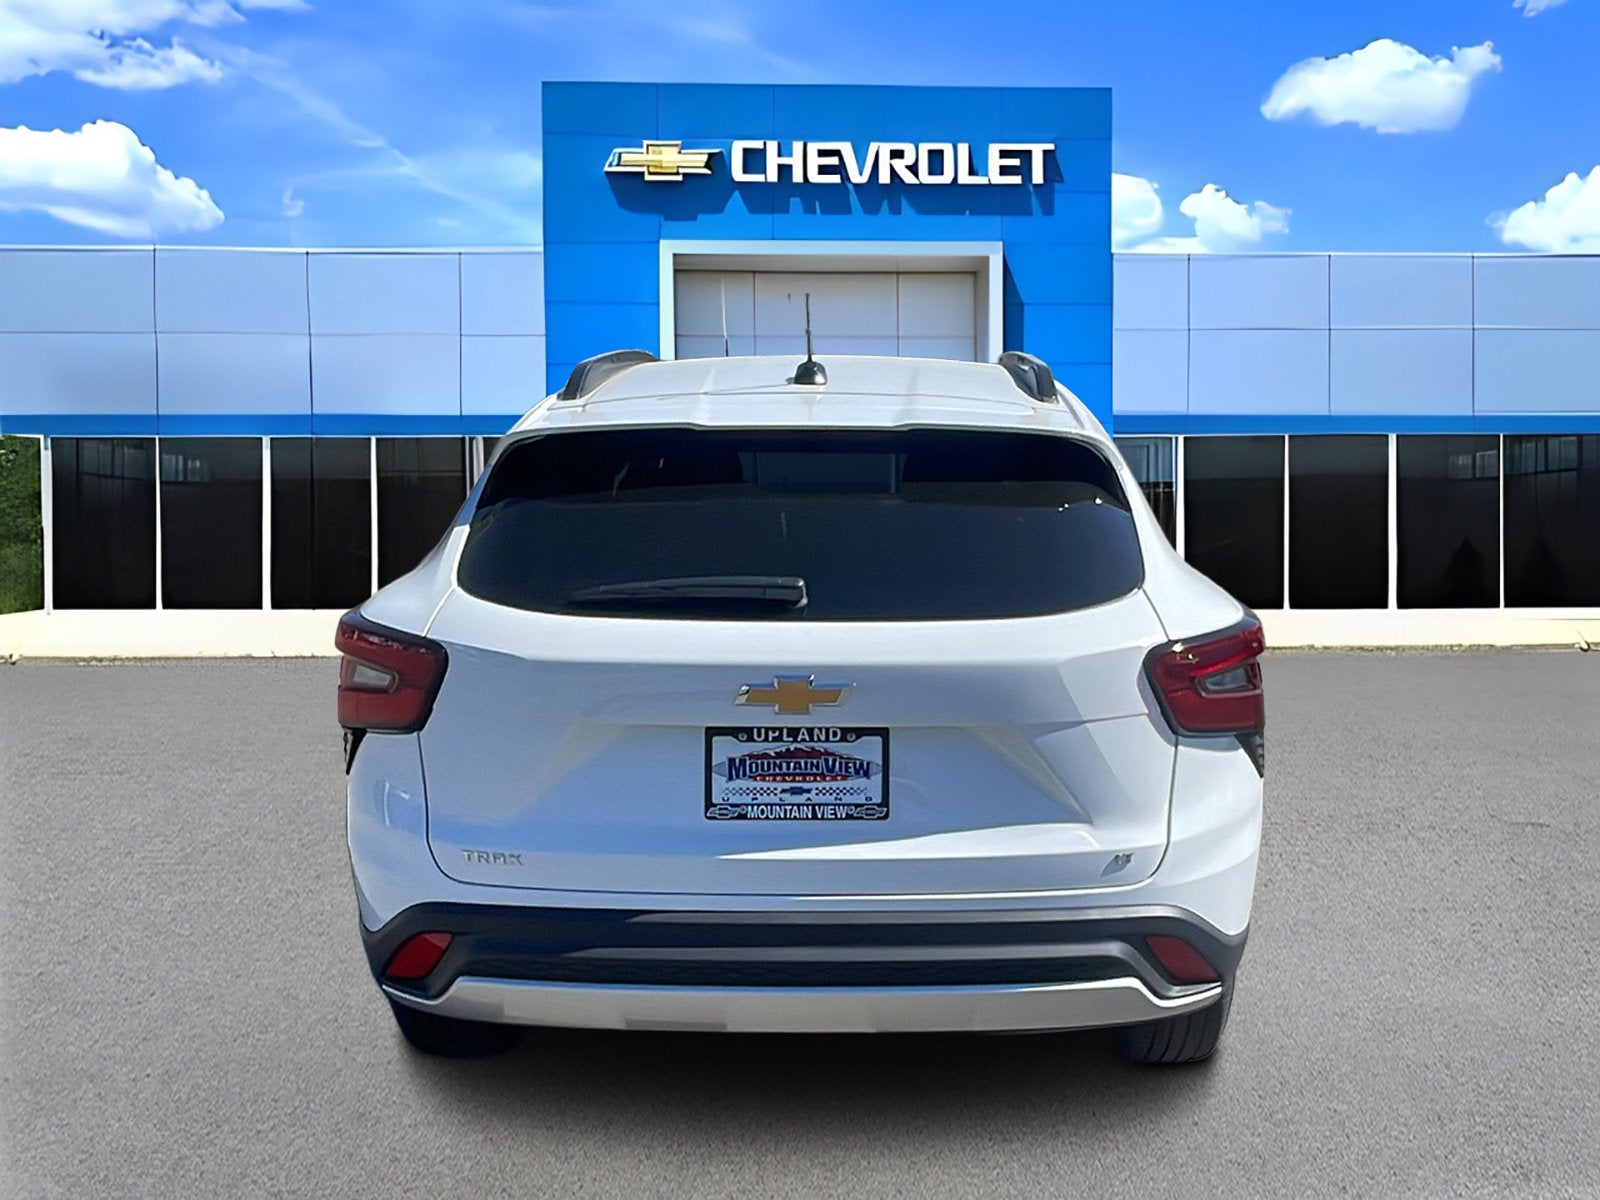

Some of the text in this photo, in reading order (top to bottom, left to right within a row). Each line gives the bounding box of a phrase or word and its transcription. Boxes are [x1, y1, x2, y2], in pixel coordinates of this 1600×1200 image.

[731, 140, 1055, 185] CHEVROLET
[753, 727, 842, 742] UPLAND
[727, 757, 871, 781] MOUNTAIN VIEW
[747, 805, 848, 818] MOUNTAIN VIEW
[462, 848, 523, 866] TRAX
